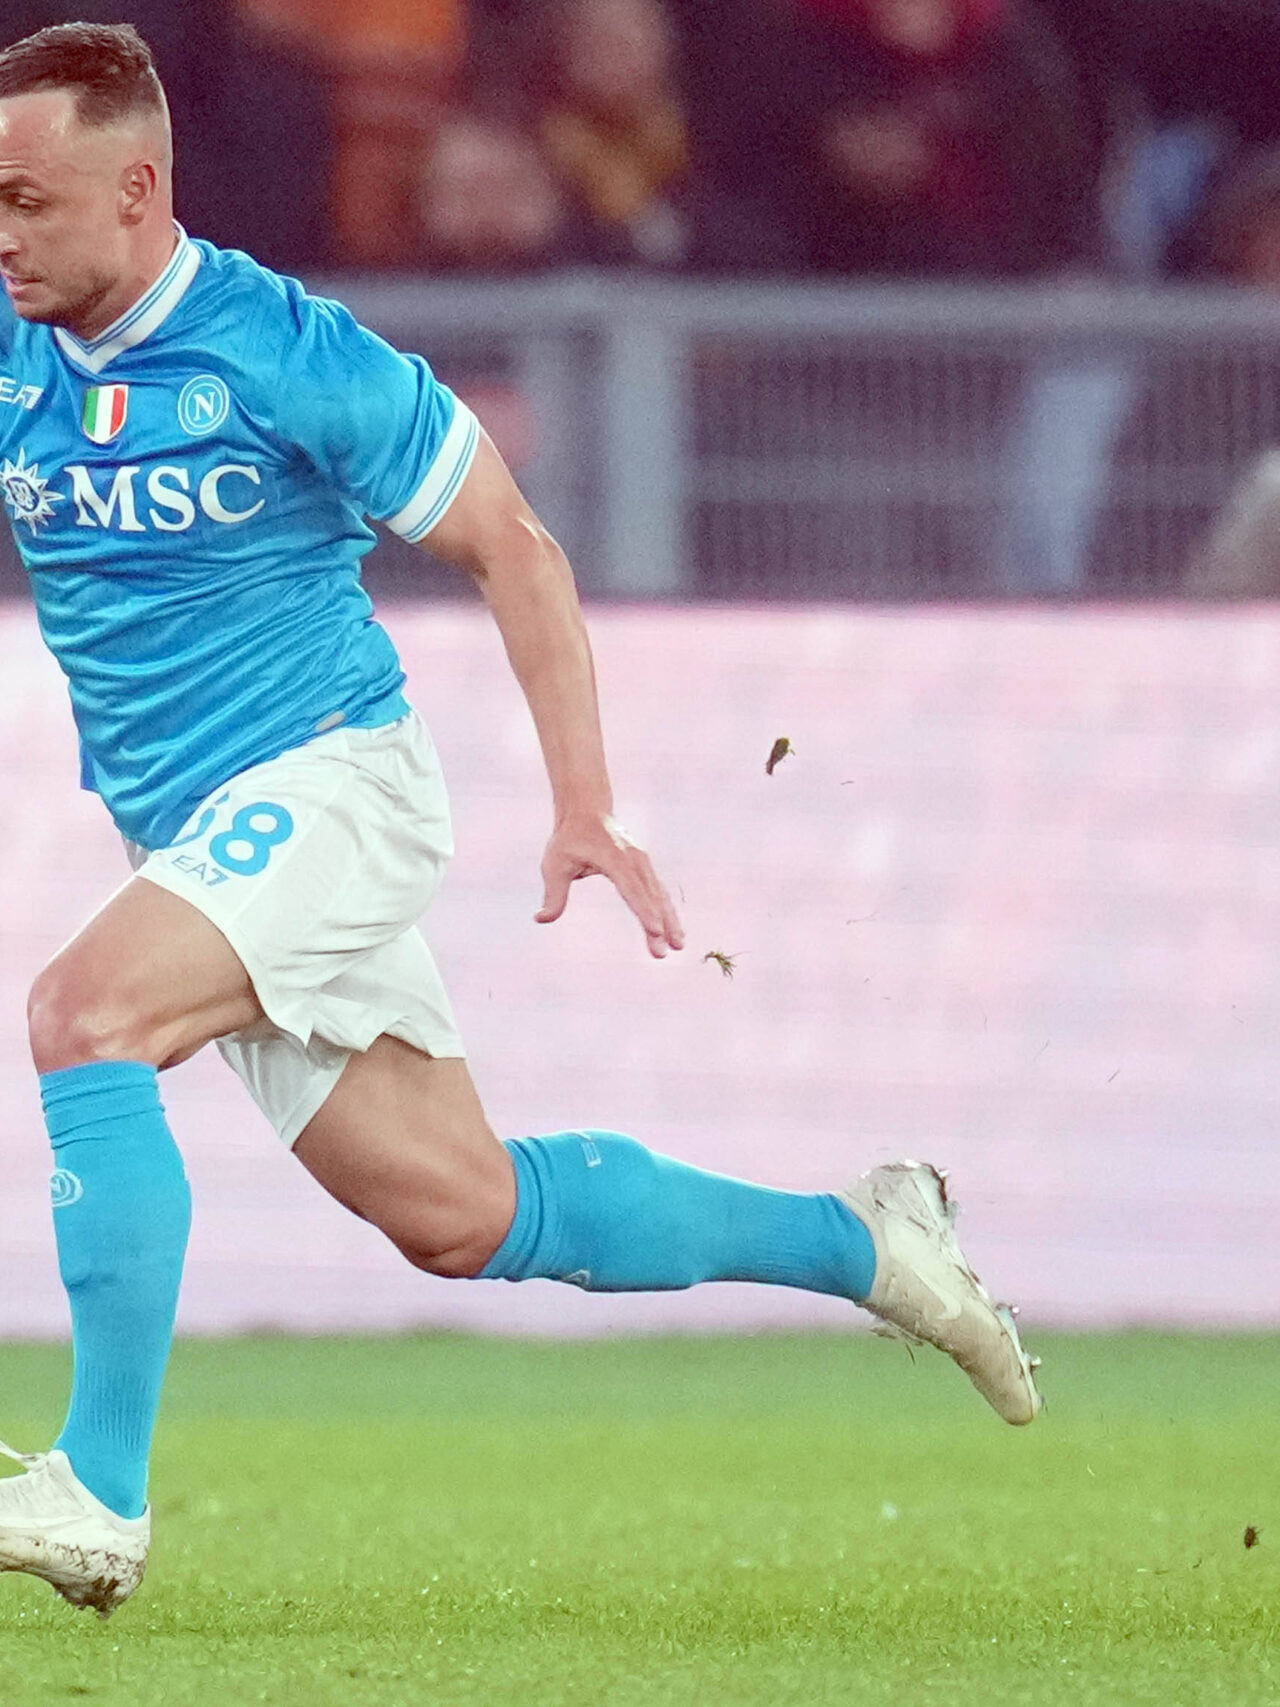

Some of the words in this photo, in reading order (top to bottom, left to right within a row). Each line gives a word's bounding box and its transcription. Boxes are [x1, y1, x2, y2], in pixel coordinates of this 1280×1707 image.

[192, 391, 216, 422] N
[63, 464, 267, 532] MSC
[171, 854, 230, 887] EA7
